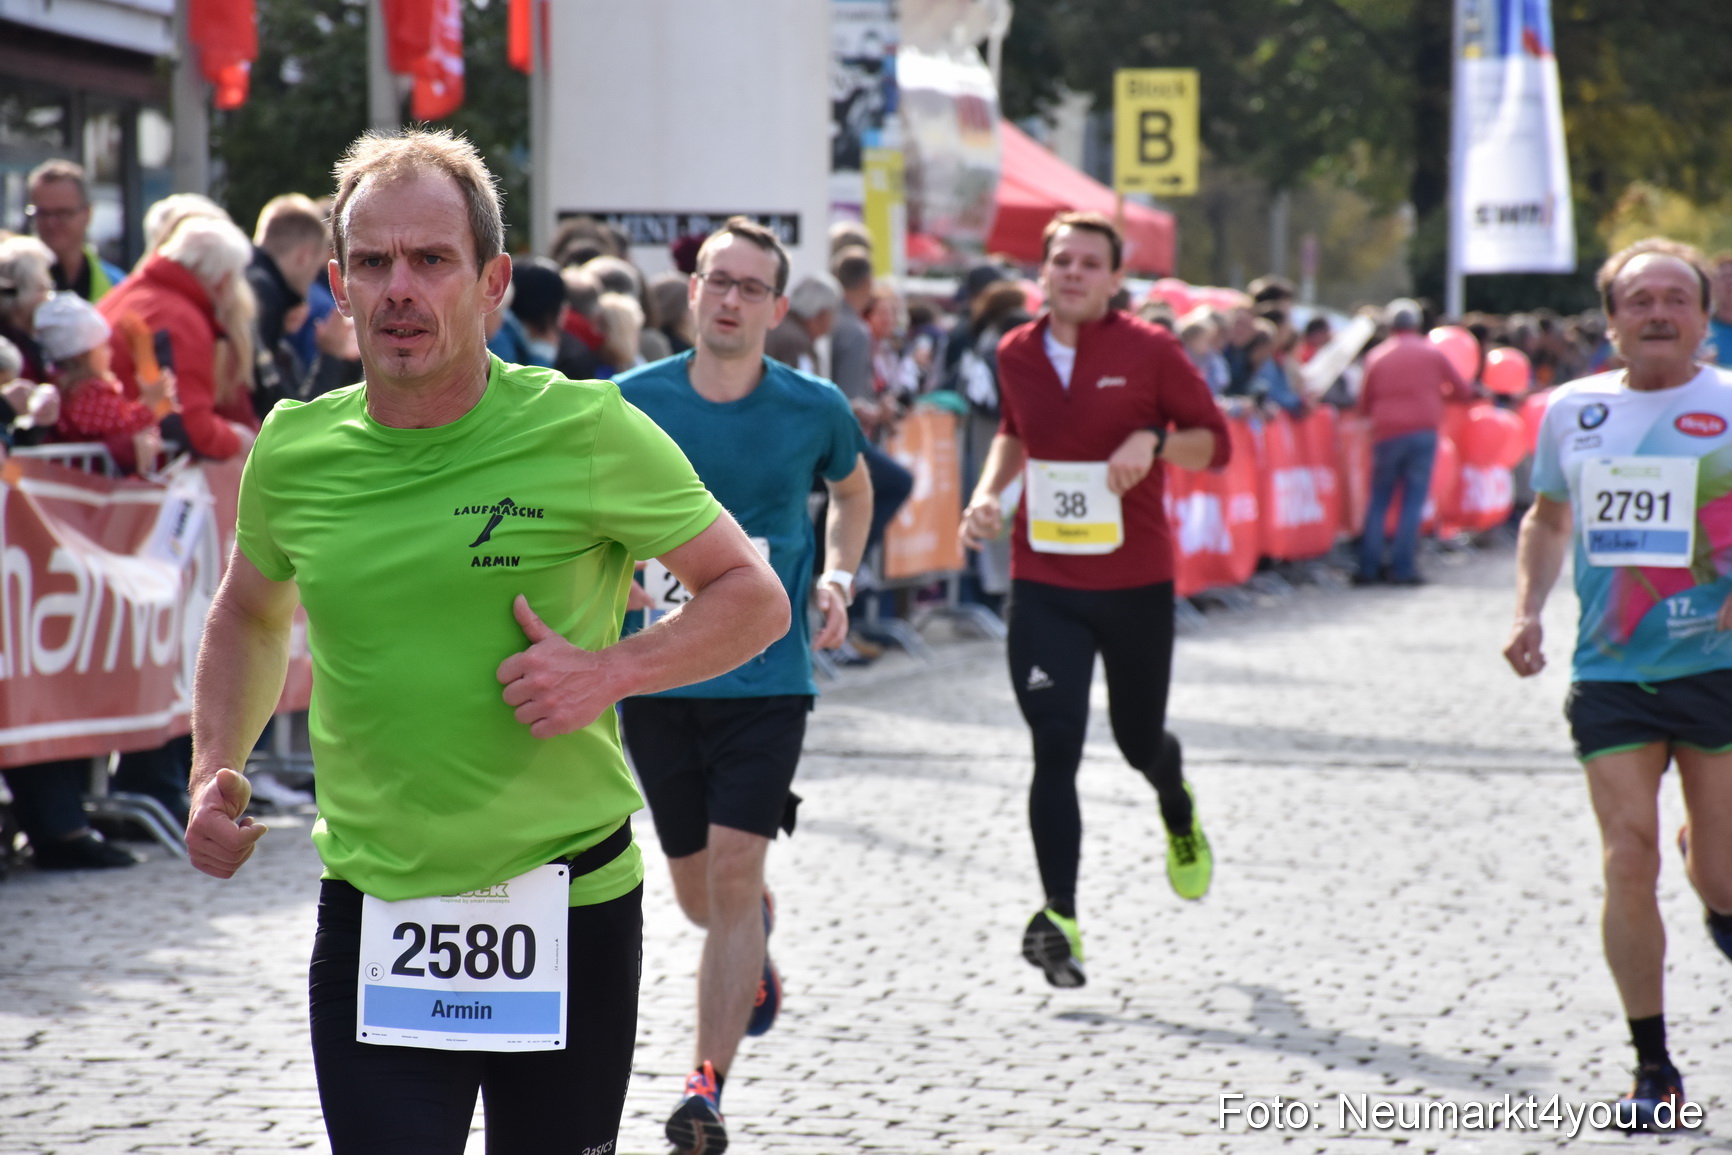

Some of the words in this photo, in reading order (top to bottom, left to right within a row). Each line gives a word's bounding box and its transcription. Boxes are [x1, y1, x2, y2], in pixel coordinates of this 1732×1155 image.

[1139, 110, 1174, 164] B
[453, 505, 544, 519] LAUFMASCHE
[1055, 491, 1087, 518] 38
[1597, 490, 1671, 522] 2791
[471, 556, 520, 568] ARMIN
[1665, 596, 1697, 617] 17.
[391, 922, 536, 980] 2580
[371, 966, 378, 977] C
[431, 999, 492, 1020] Armin
